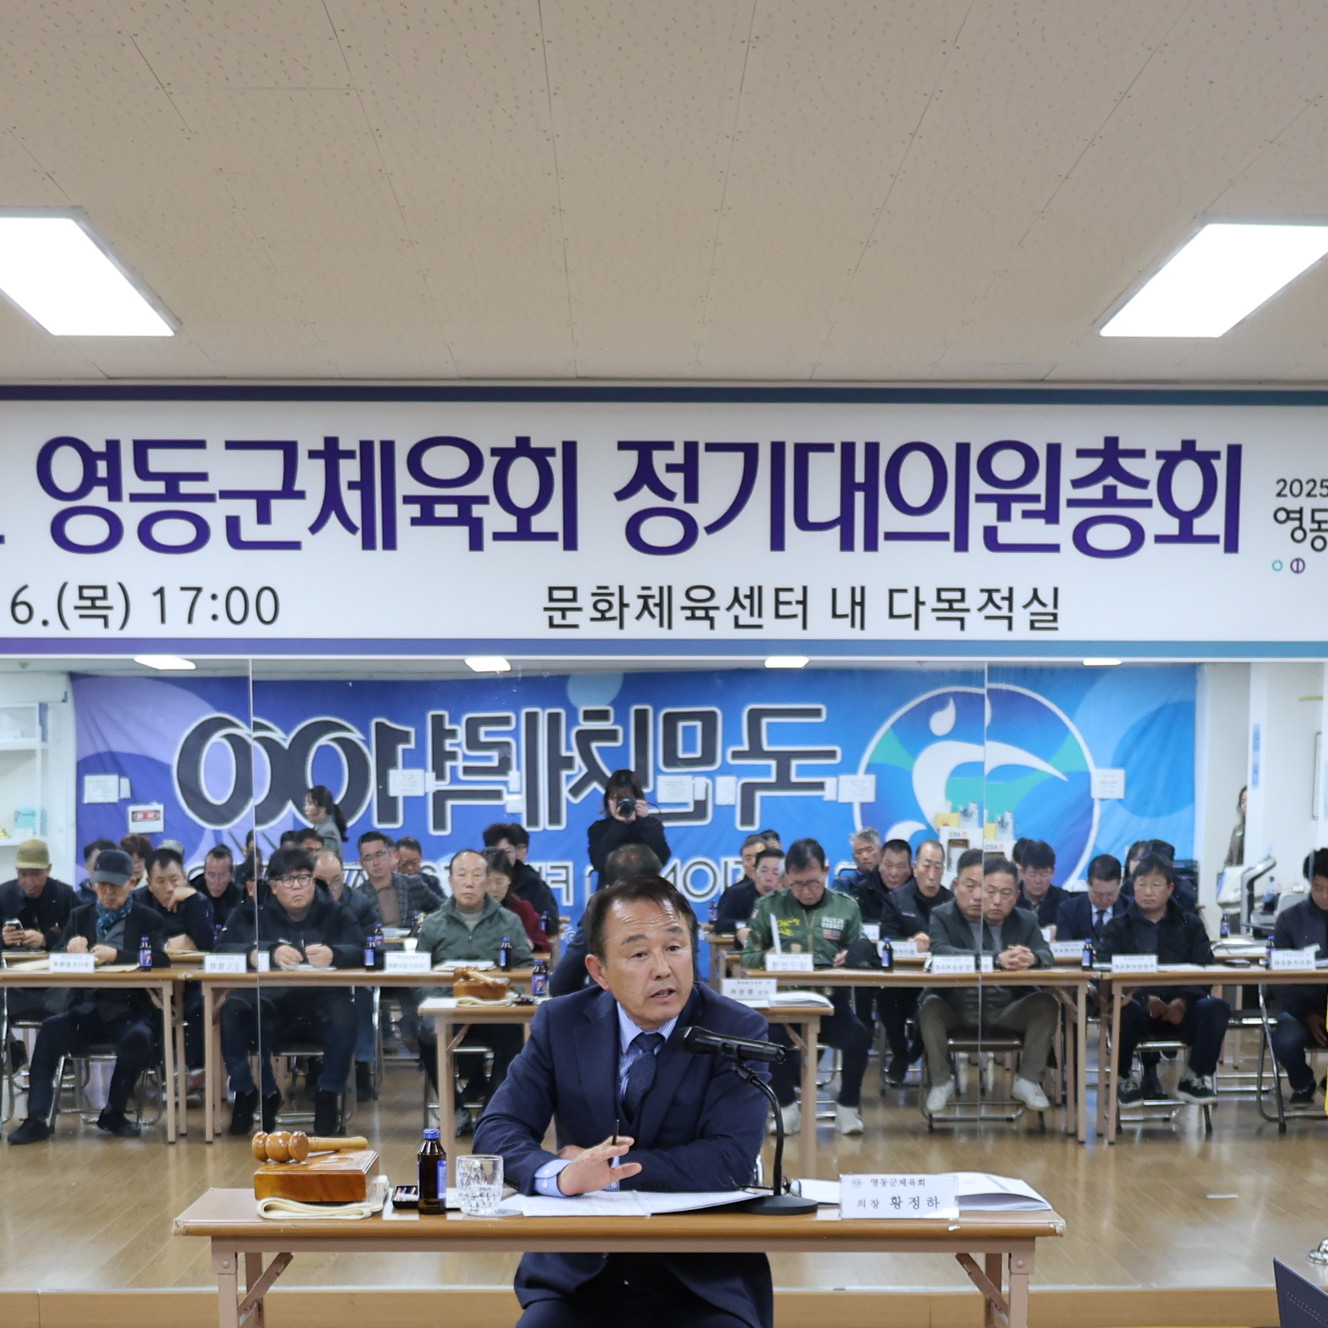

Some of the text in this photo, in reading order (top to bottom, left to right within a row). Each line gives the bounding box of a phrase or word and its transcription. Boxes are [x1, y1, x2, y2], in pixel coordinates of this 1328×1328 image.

[35, 435, 579, 555] 영동군체육회
[613, 435, 1243, 559] 정기대의원총회
[151, 585, 280, 626] 17:00
[542, 584, 809, 631] 문화체육센터
[830, 585, 866, 632] 내
[887, 585, 1059, 632] 다목적실
